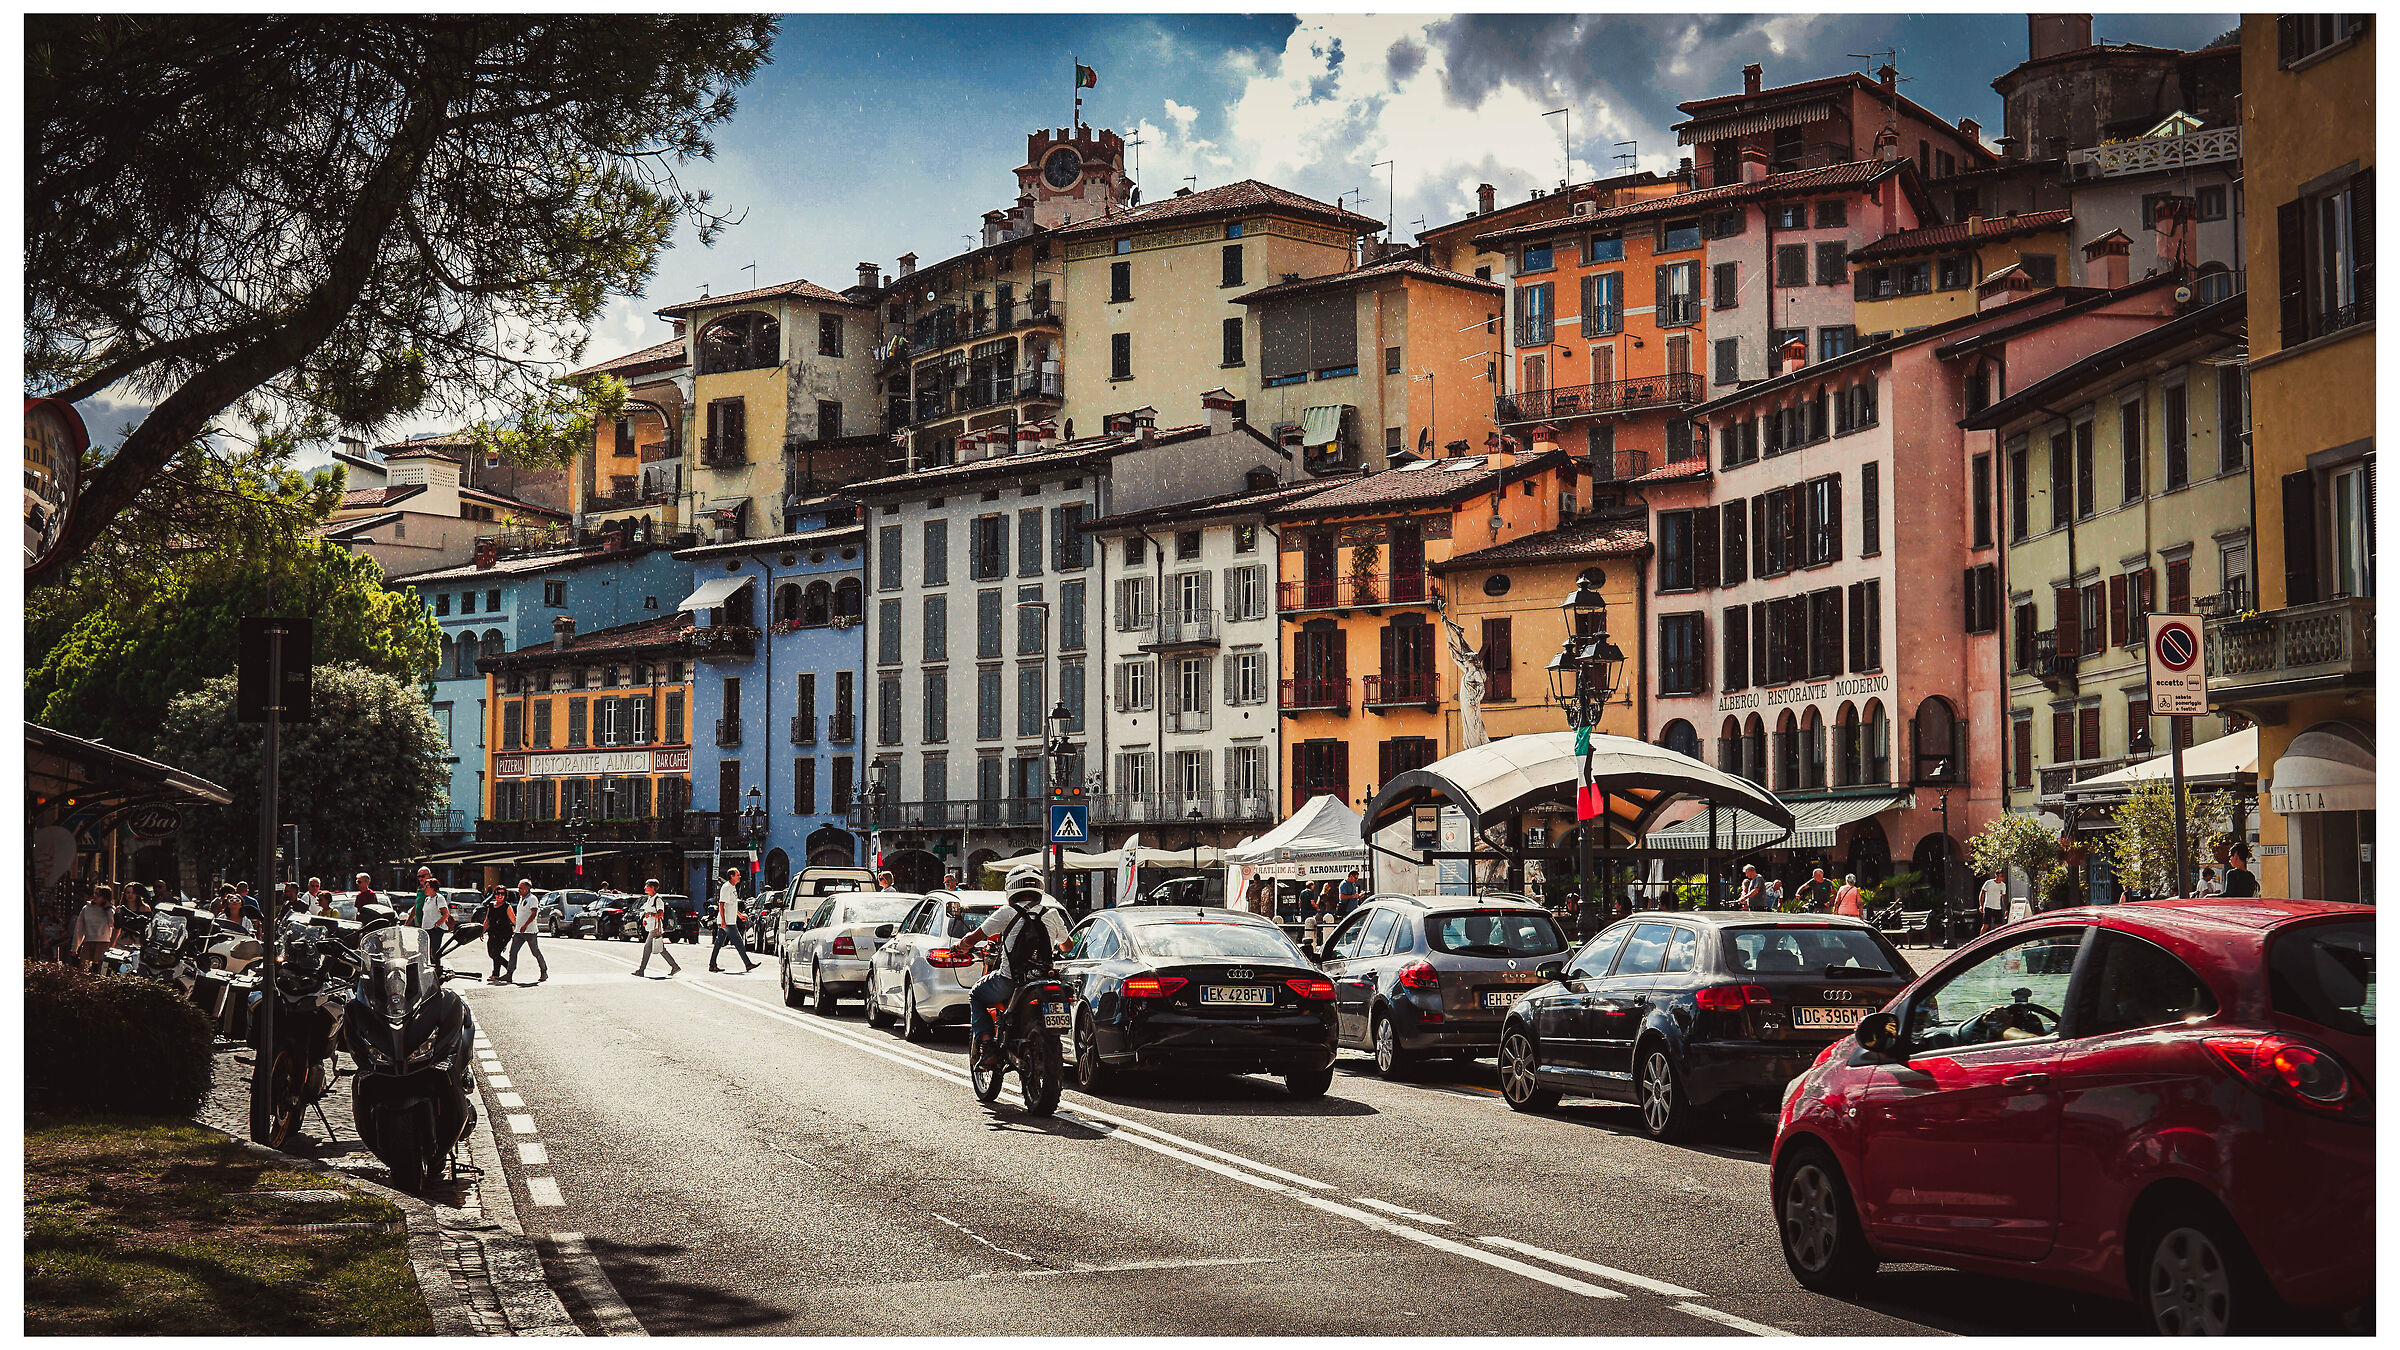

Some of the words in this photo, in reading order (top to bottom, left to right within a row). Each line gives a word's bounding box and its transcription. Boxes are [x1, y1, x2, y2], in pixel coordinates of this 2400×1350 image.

[1718, 693, 1760, 711] ALBERGO
[1767, 684, 1827, 706] RISTORANTE
[1836, 675, 1889, 697] MODERNO
[500, 758, 524, 774] PIZZERIA
[534, 756, 600, 773] RISTORANTE
[605, 754, 646, 771] ALMICI
[656, 754, 669, 768] BAR
[2271, 793, 2326, 810] NETTA
[135, 811, 177, 829] Bar
[1295, 851, 1337, 859] AERONAUTICA
[1309, 864, 1360, 875] AERONAUTICA
[1045, 1015, 1070, 1026] 83059
